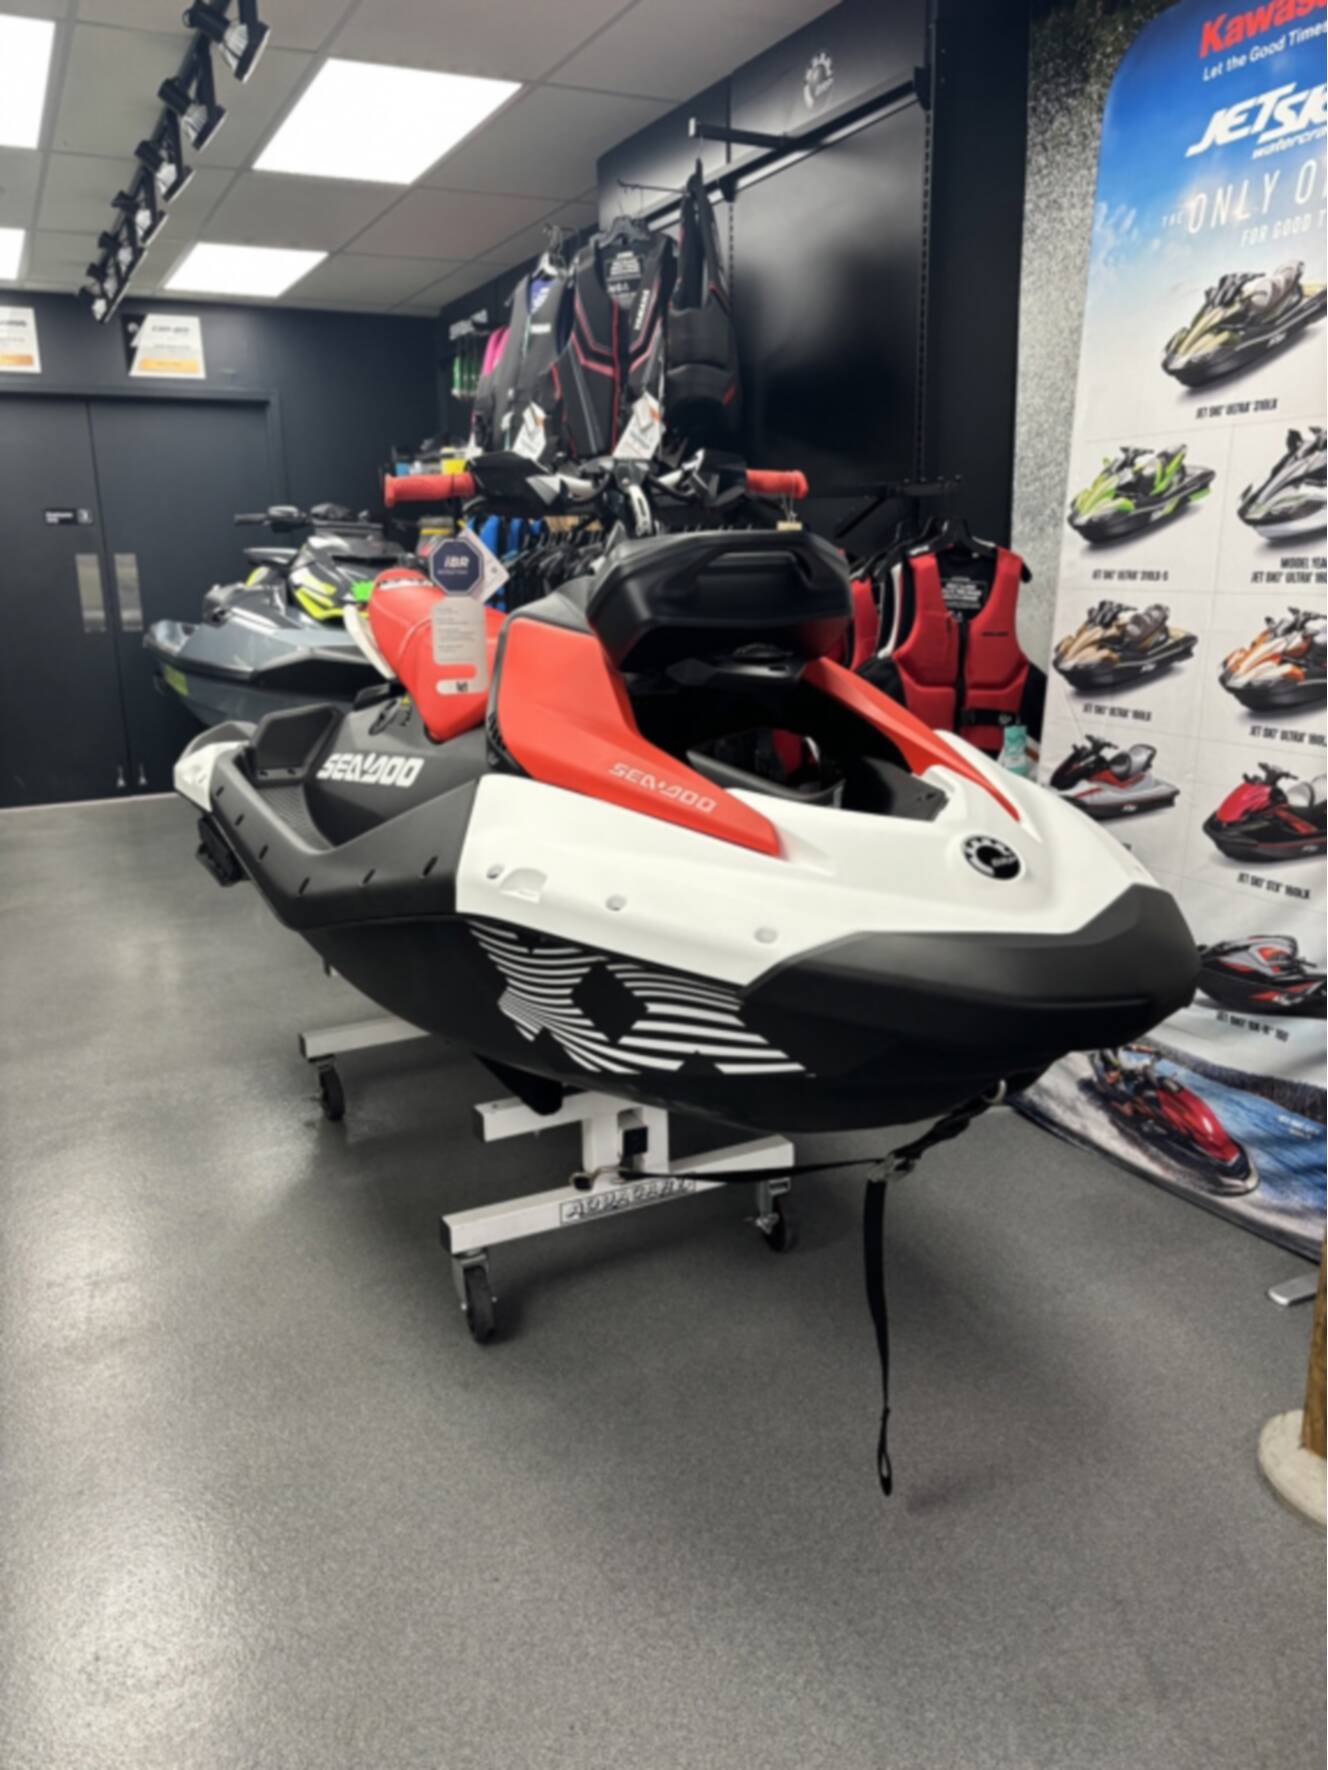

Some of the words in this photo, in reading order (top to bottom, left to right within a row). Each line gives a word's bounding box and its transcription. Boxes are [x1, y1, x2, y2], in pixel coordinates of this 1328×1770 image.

[1203, 61, 1223, 81] Let
[1226, 54, 1247, 72] the
[1249, 35, 1287, 62] Good
[1187, 169, 1281, 234] ONLY
[1272, 212, 1313, 239] GOOD
